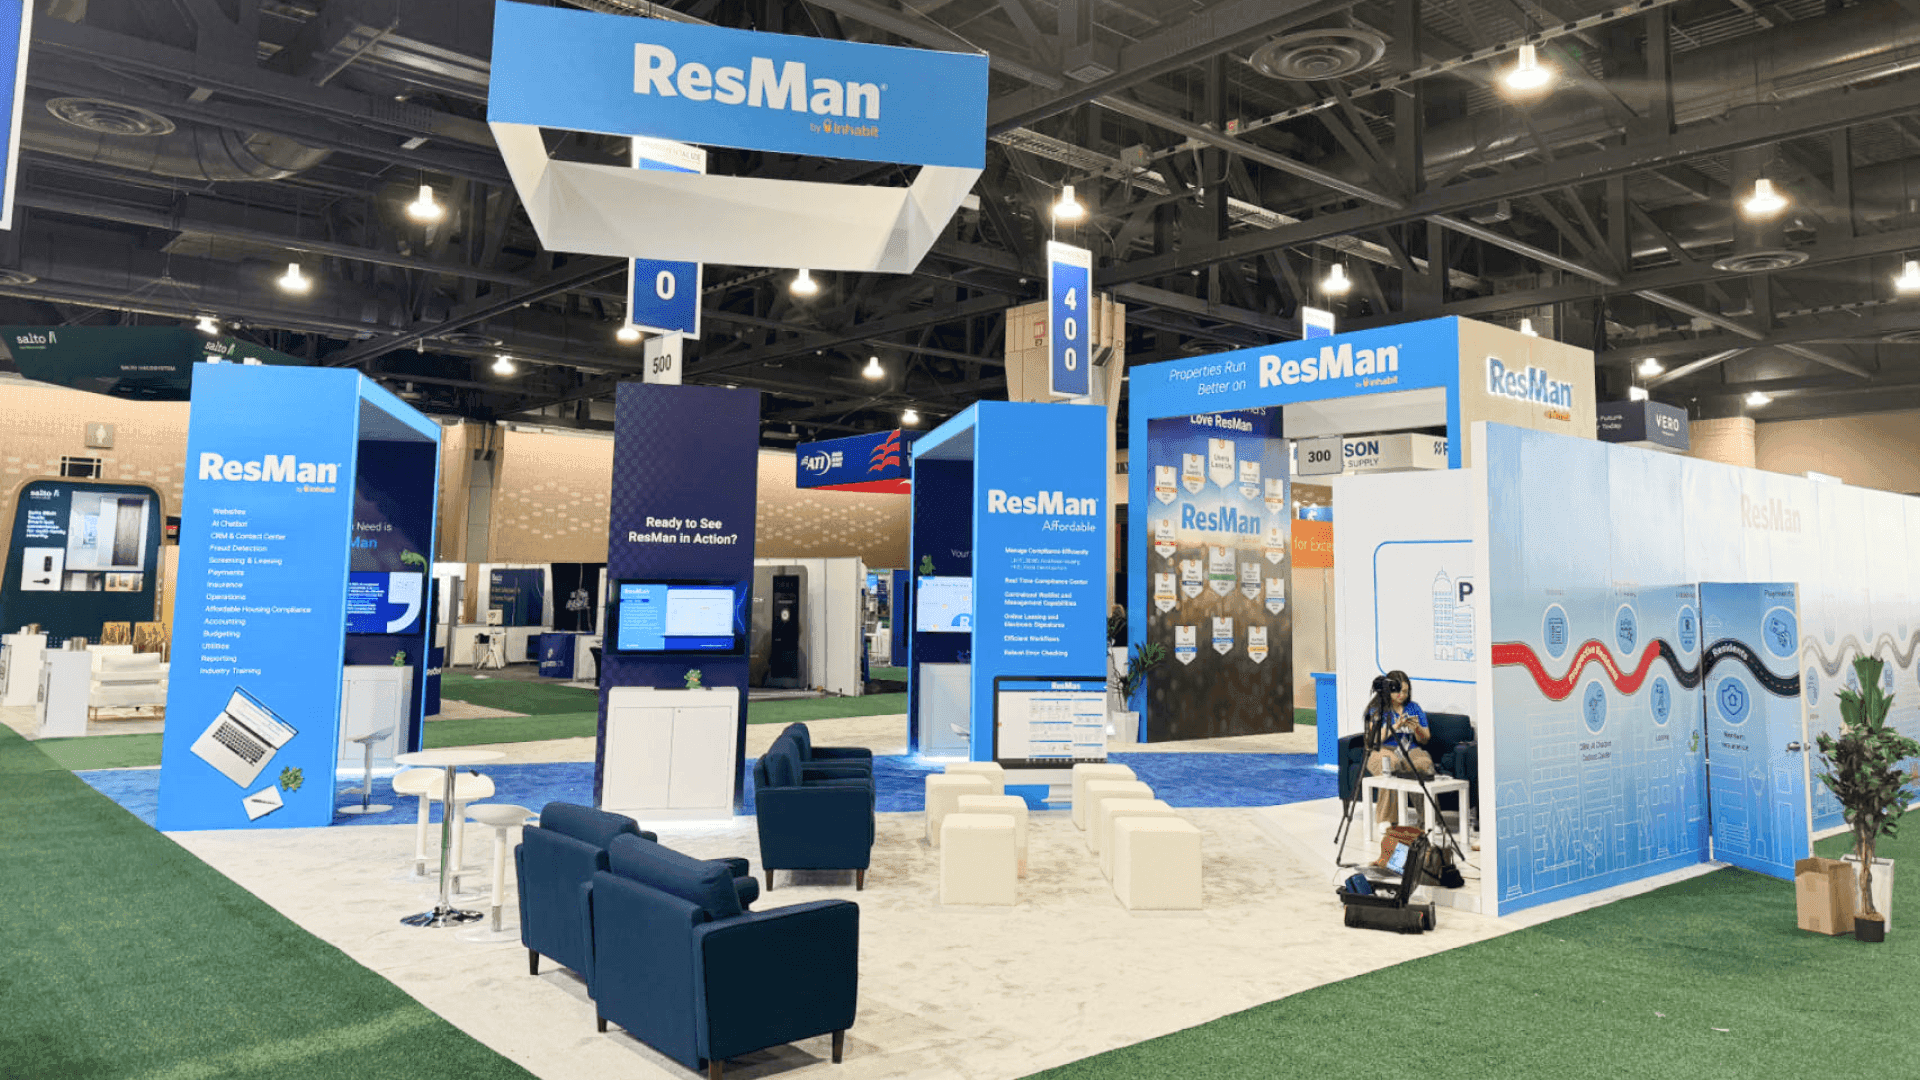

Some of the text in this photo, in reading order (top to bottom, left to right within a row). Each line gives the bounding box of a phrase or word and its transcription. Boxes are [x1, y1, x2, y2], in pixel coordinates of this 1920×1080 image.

[633, 42, 881, 121] ResMan
[656, 270, 676, 301] 0
[1064, 286, 1078, 372] 400
[16, 332, 47, 344] salto
[204, 340, 228, 354] salto
[652, 353, 672, 375] 500
[1259, 343, 1399, 389] ResMan
[1168, 360, 1247, 381] Properties Run
[1487, 356, 1572, 409] ResMan
[1197, 381, 1247, 396] Better on
[1190, 414, 1253, 432] Love ResMan
[1656, 414, 1680, 432] VERO
[1344, 440, 1380, 457] SON
[1308, 450, 1331, 463] 300
[198, 451, 338, 484] ResMan
[1347, 458, 1380, 468] SUPPLY
[987, 488, 1097, 516] ResMan
[212, 507, 247, 515] Websites
[1741, 492, 1801, 534] ResMan
[220, 519, 248, 527] Chatbot
[646, 516, 723, 531] Ready to See
[1180, 502, 1261, 535] ResMan
[356, 521, 392, 531] Need is
[1041, 519, 1097, 532] Affordable
[210, 532, 228, 540] CRM
[235, 533, 263, 541] Contact
[263, 533, 286, 541] Center
[628, 531, 738, 545] ResMan in Action?
[209, 544, 268, 552] Fraud Detection
[1293, 536, 1306, 550] for
[951, 549, 969, 559] Your
[1004, 546, 1090, 556] Manage Compliance Efficiently
[208, 556, 246, 565] Screening
[253, 557, 283, 566] Leasing
[207, 568, 245, 577] Payments
[206, 581, 243, 589] Insurance
[1004, 576, 1019, 584] Real
[1019, 576, 1034, 584] Time
[1034, 578, 1068, 586] Compliance
[206, 593, 247, 601] Operations
[1458, 581, 1474, 602] P
[1004, 599, 1077, 608] Management Capabilities
[205, 605, 312, 615] Affordable Housing Compliance
[204, 617, 247, 627] Accounting
[1024, 613, 1047, 621] Leasing
[203, 629, 242, 639] Budgeting
[202, 642, 230, 650] Utilities
[201, 654, 238, 663] Reporting
[1041, 650, 1069, 658] Checking
[199, 667, 262, 676] Industry Training
[1050, 681, 1081, 690] ResMan
